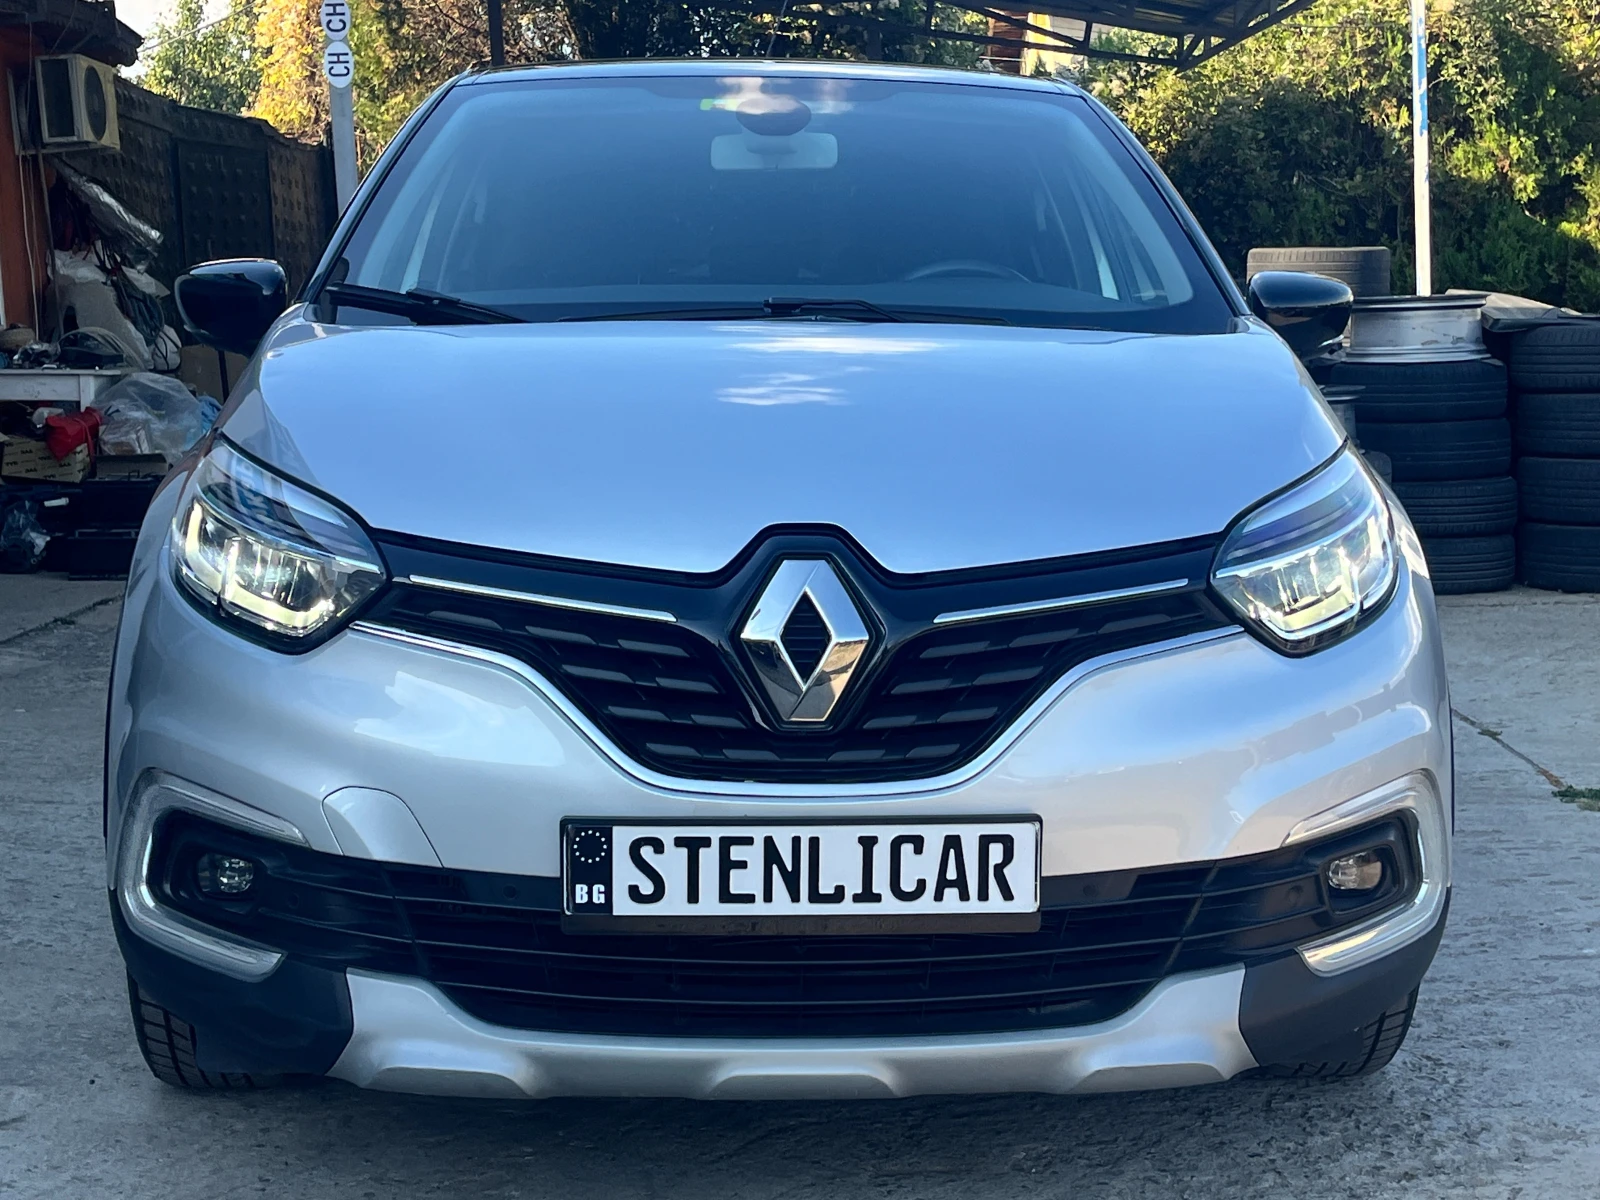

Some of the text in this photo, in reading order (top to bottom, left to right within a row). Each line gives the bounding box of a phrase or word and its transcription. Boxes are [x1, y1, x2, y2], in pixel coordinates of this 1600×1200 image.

[324, 3, 346, 33] CH
[327, 53, 350, 77] CH
[628, 834, 1014, 904] STENLICAR
[575, 884, 605, 904] BG
